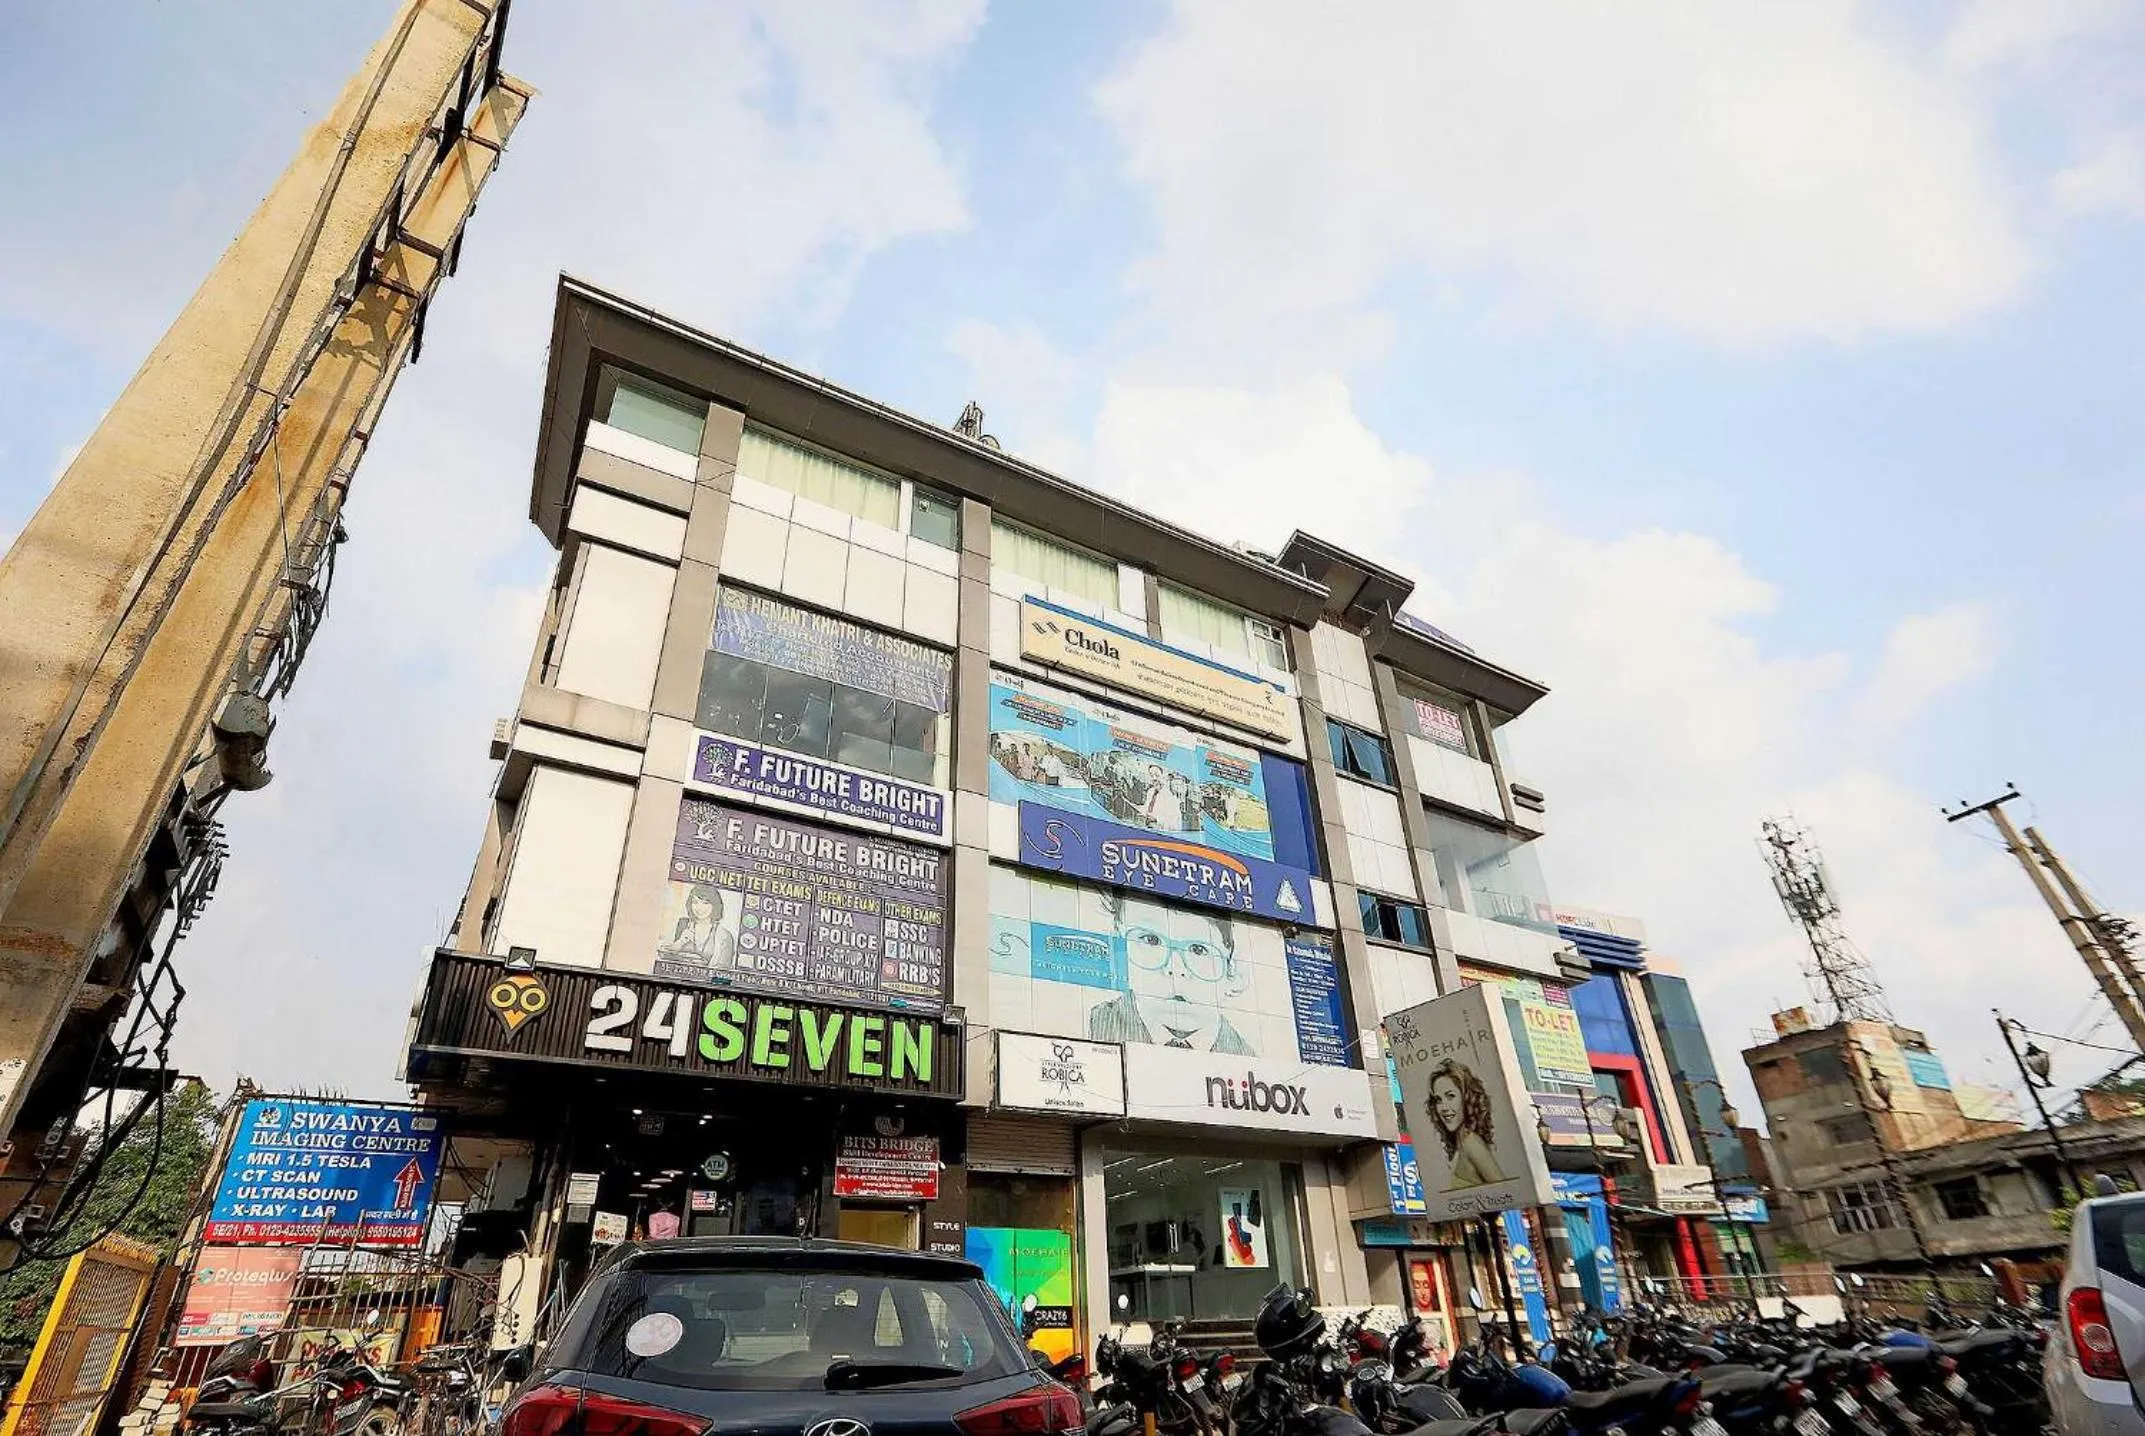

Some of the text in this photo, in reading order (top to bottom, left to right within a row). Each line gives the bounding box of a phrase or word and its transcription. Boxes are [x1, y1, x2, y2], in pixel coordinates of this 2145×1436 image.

[811, 612, 860, 642] KHATRI
[862, 629, 873, 646] &
[876, 632, 953, 671] ASSOCIATES
[1064, 628, 1121, 661] Chola
[733, 748, 941, 818] F. FUTURE BRIGHT
[730, 773, 938, 832] Faridabad's Best Coaching Centre
[726, 817, 745, 841] F.
[754, 824, 848, 862] FUTURE
[857, 845, 939, 881] BRIGHT
[689, 865, 743, 887] UGC NET
[725, 839, 938, 892] Faridabad's Best Coaching Centre
[754, 861, 806, 881] COURSES
[1101, 842, 1253, 896] SUNETRAM
[745, 874, 812, 901] TET EXAMS
[1103, 863, 1254, 911] EYE CARE
[762, 898, 803, 917] CTET
[817, 889, 880, 914] DEFENCE EXAMS
[820, 908, 853, 928] NDA
[884, 902, 941, 925] OTHER EXAMS
[760, 917, 800, 936] HTET
[900, 922, 928, 943] SSC
[759, 935, 806, 956] UPTET
[818, 926, 878, 950] POLICE
[757, 955, 805, 977] DSSSB
[899, 945, 942, 967] BANKING
[815, 964, 877, 988] PARAMILITARY
[899, 962, 941, 986] RRB'S
[1041, 1067, 1085, 1083] ROBICA
[289, 1111, 402, 1134] SWANYA
[250, 1130, 431, 1153] IMAGING CENTRE
[844, 1136, 933, 1153] BITS BRIDGE
[246, 1152, 372, 1170] MRI 1.5 TESLA
[706, 1159, 726, 1171] ATM
[241, 1169, 321, 1184] CT SCAN
[236, 1186, 359, 1202] ULTRASOUND
[230, 1203, 337, 1218] X-RAY LAB
[933, 1221, 961, 1231] STYLE
[930, 1242, 961, 1252] STUDIO
